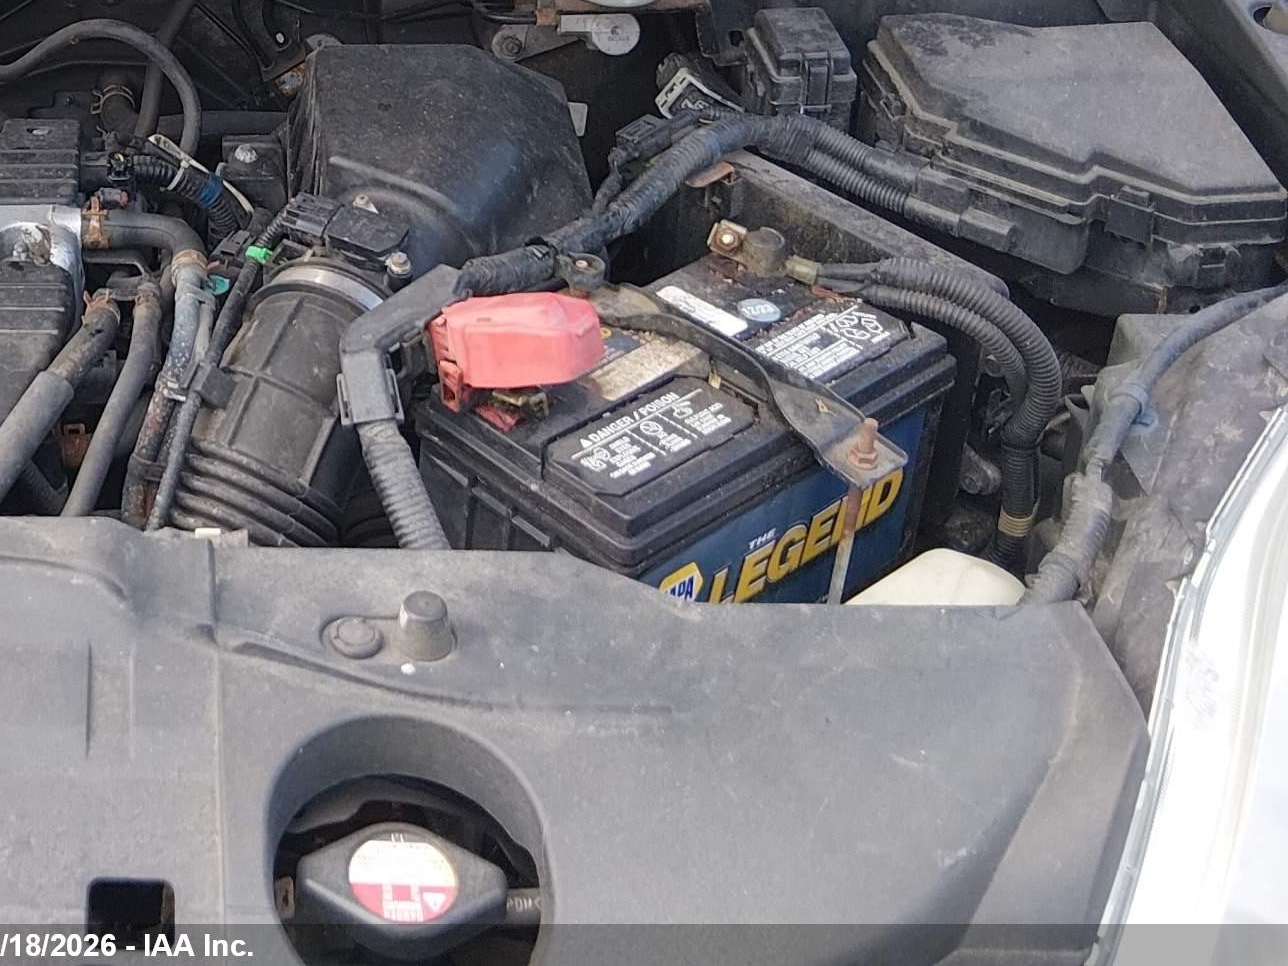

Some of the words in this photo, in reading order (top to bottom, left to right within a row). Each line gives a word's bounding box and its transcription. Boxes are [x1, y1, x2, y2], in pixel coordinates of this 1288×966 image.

[589, 415, 634, 443] DANGER
[639, 391, 680, 417] POISON
[748, 528, 776, 550] THE
